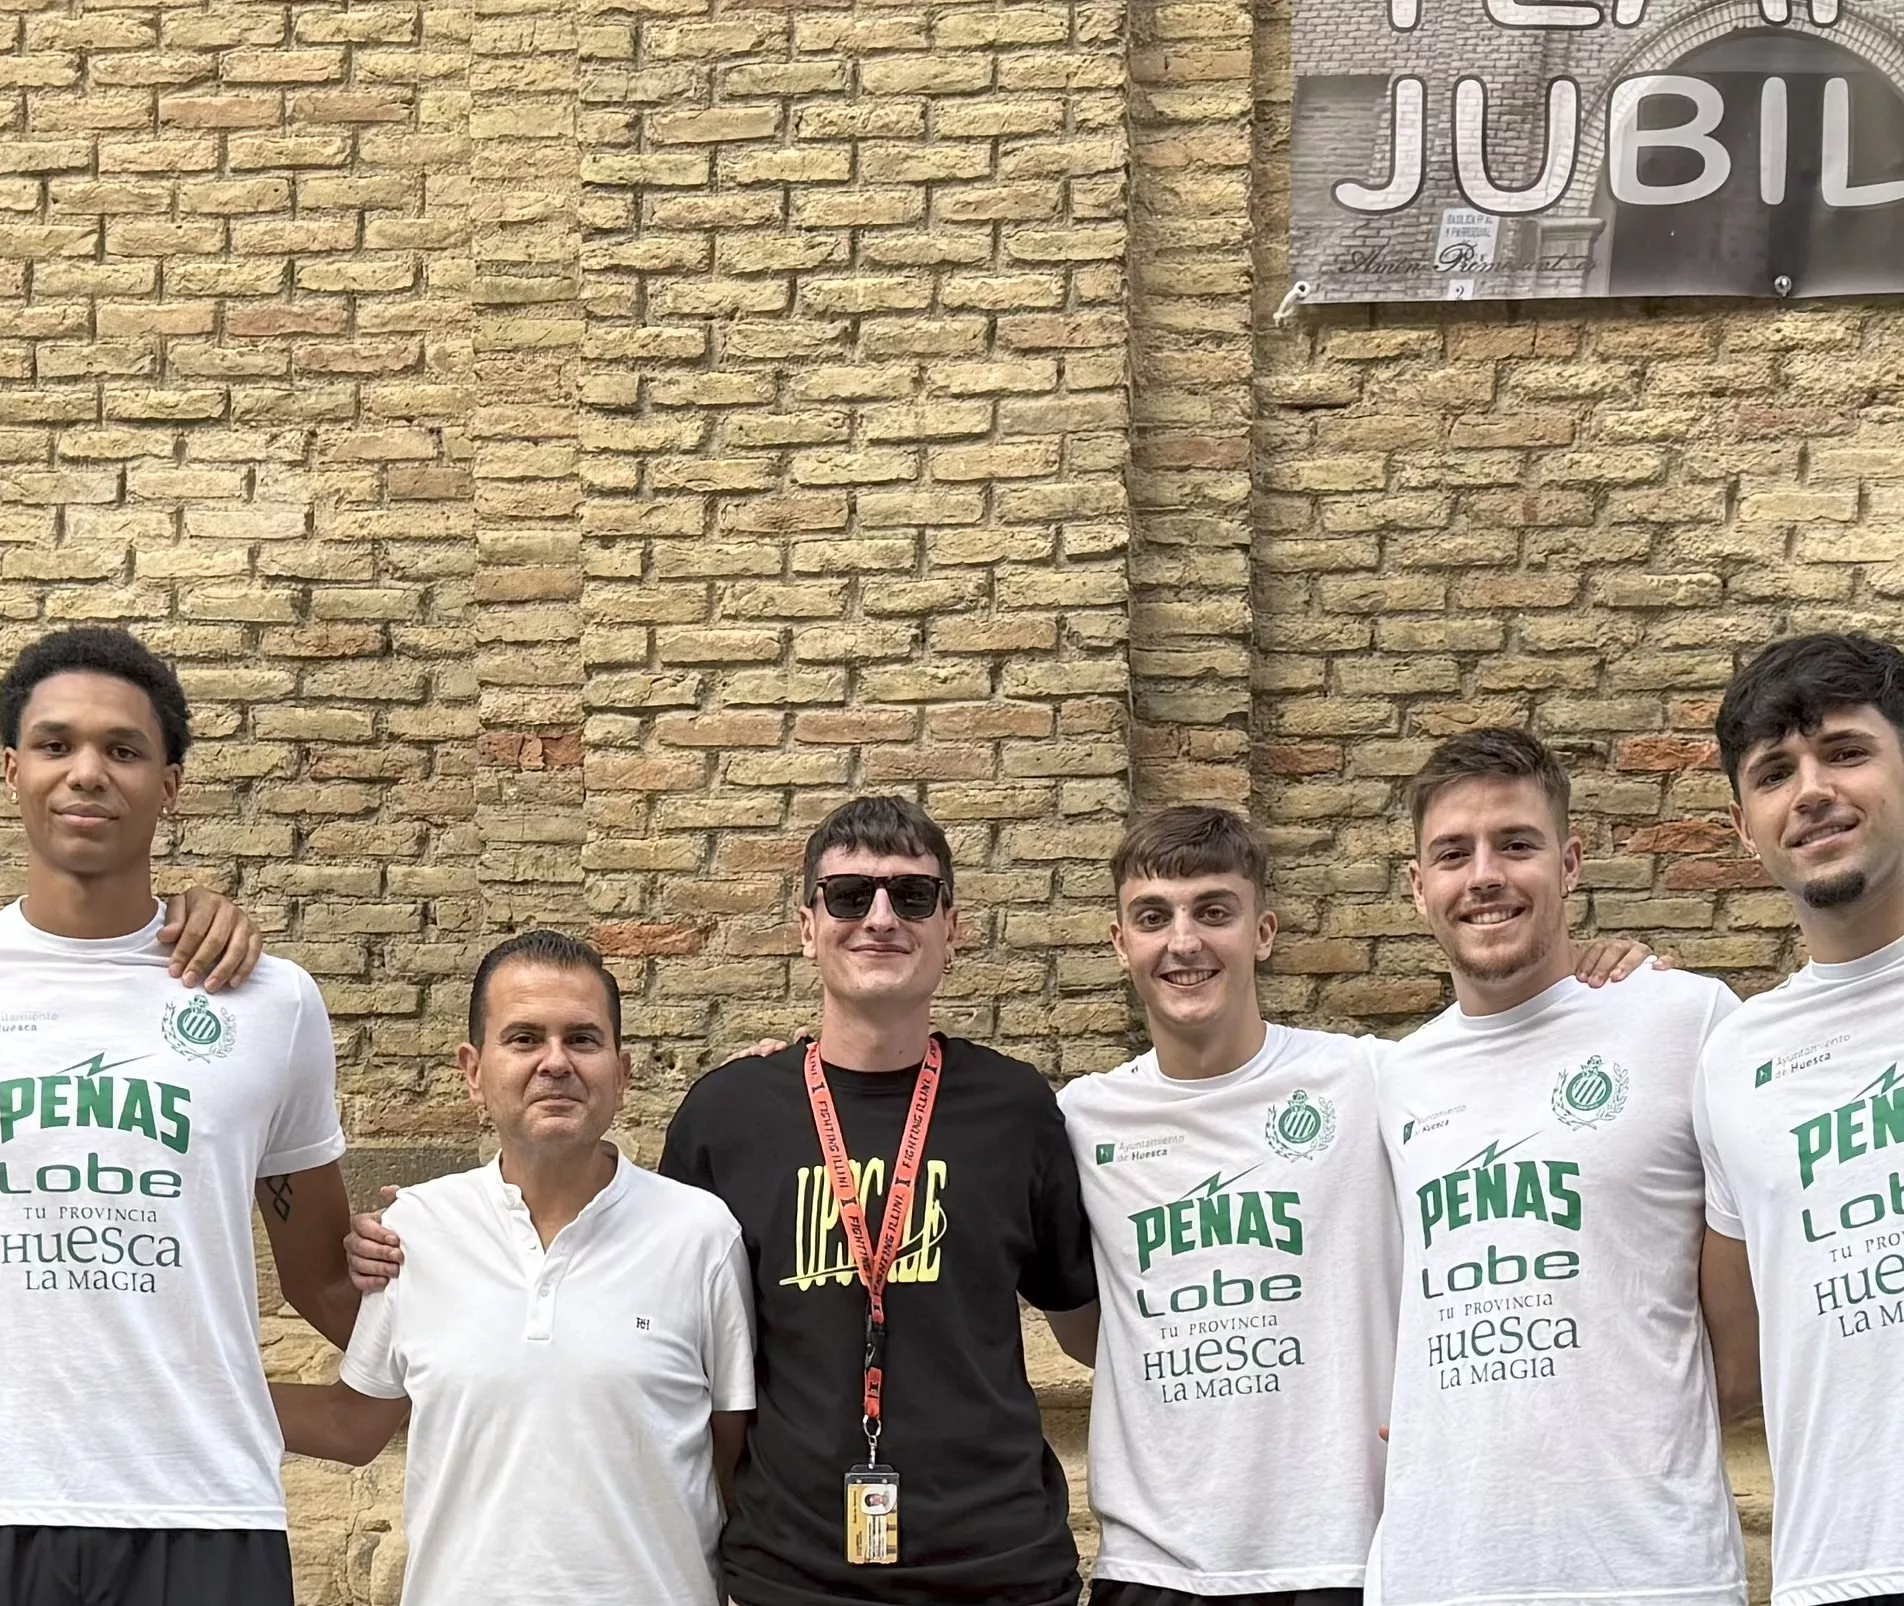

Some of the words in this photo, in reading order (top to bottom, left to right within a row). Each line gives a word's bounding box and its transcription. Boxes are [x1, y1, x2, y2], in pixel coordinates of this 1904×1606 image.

[1128, 1163, 1303, 1274] PEÑAS
[1416, 1129, 1581, 1250] PEÑAS
[1136, 1269, 1302, 1318] Lobe
[1422, 1245, 1580, 1299] Lobe
